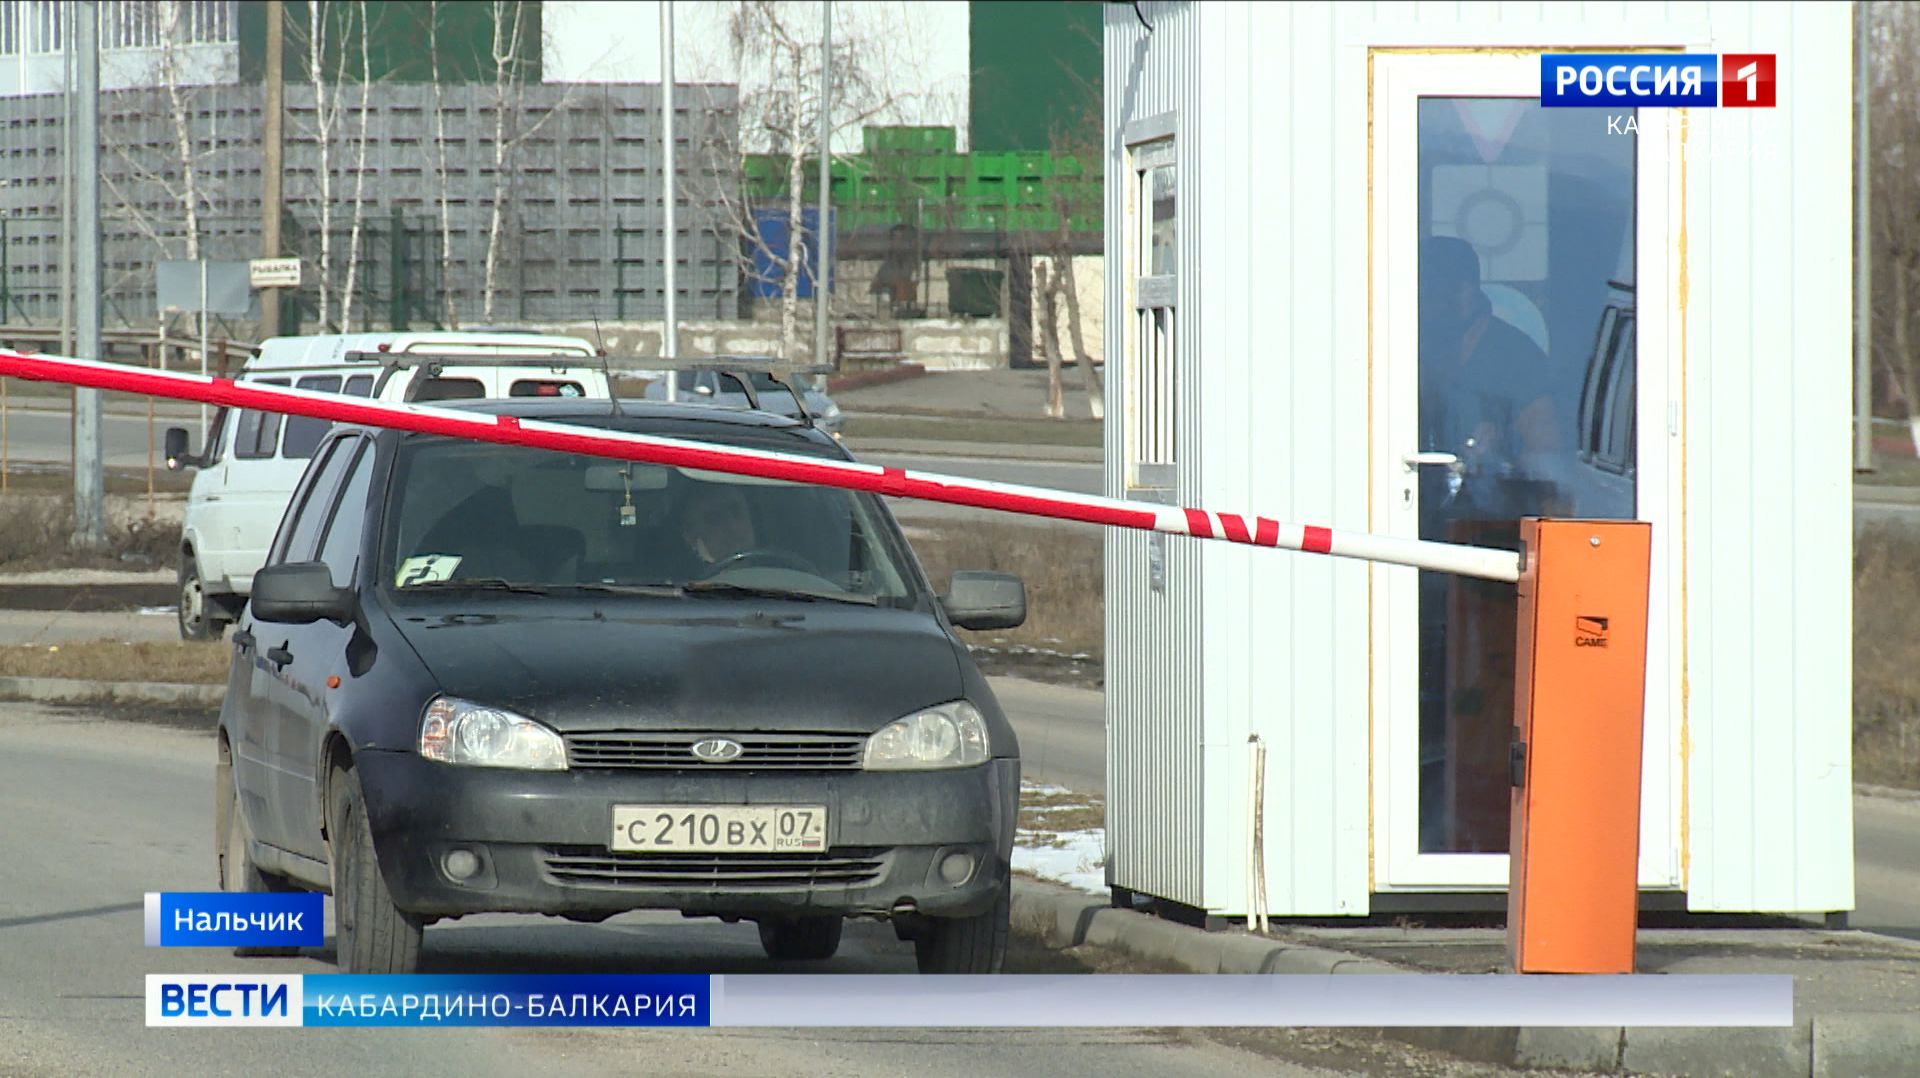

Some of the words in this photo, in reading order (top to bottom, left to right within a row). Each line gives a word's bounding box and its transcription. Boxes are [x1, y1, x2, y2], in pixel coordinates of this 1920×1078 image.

[1575, 636, 1608, 648] CAME
[779, 812, 814, 837] 07
[776, 838, 801, 847] RUS
